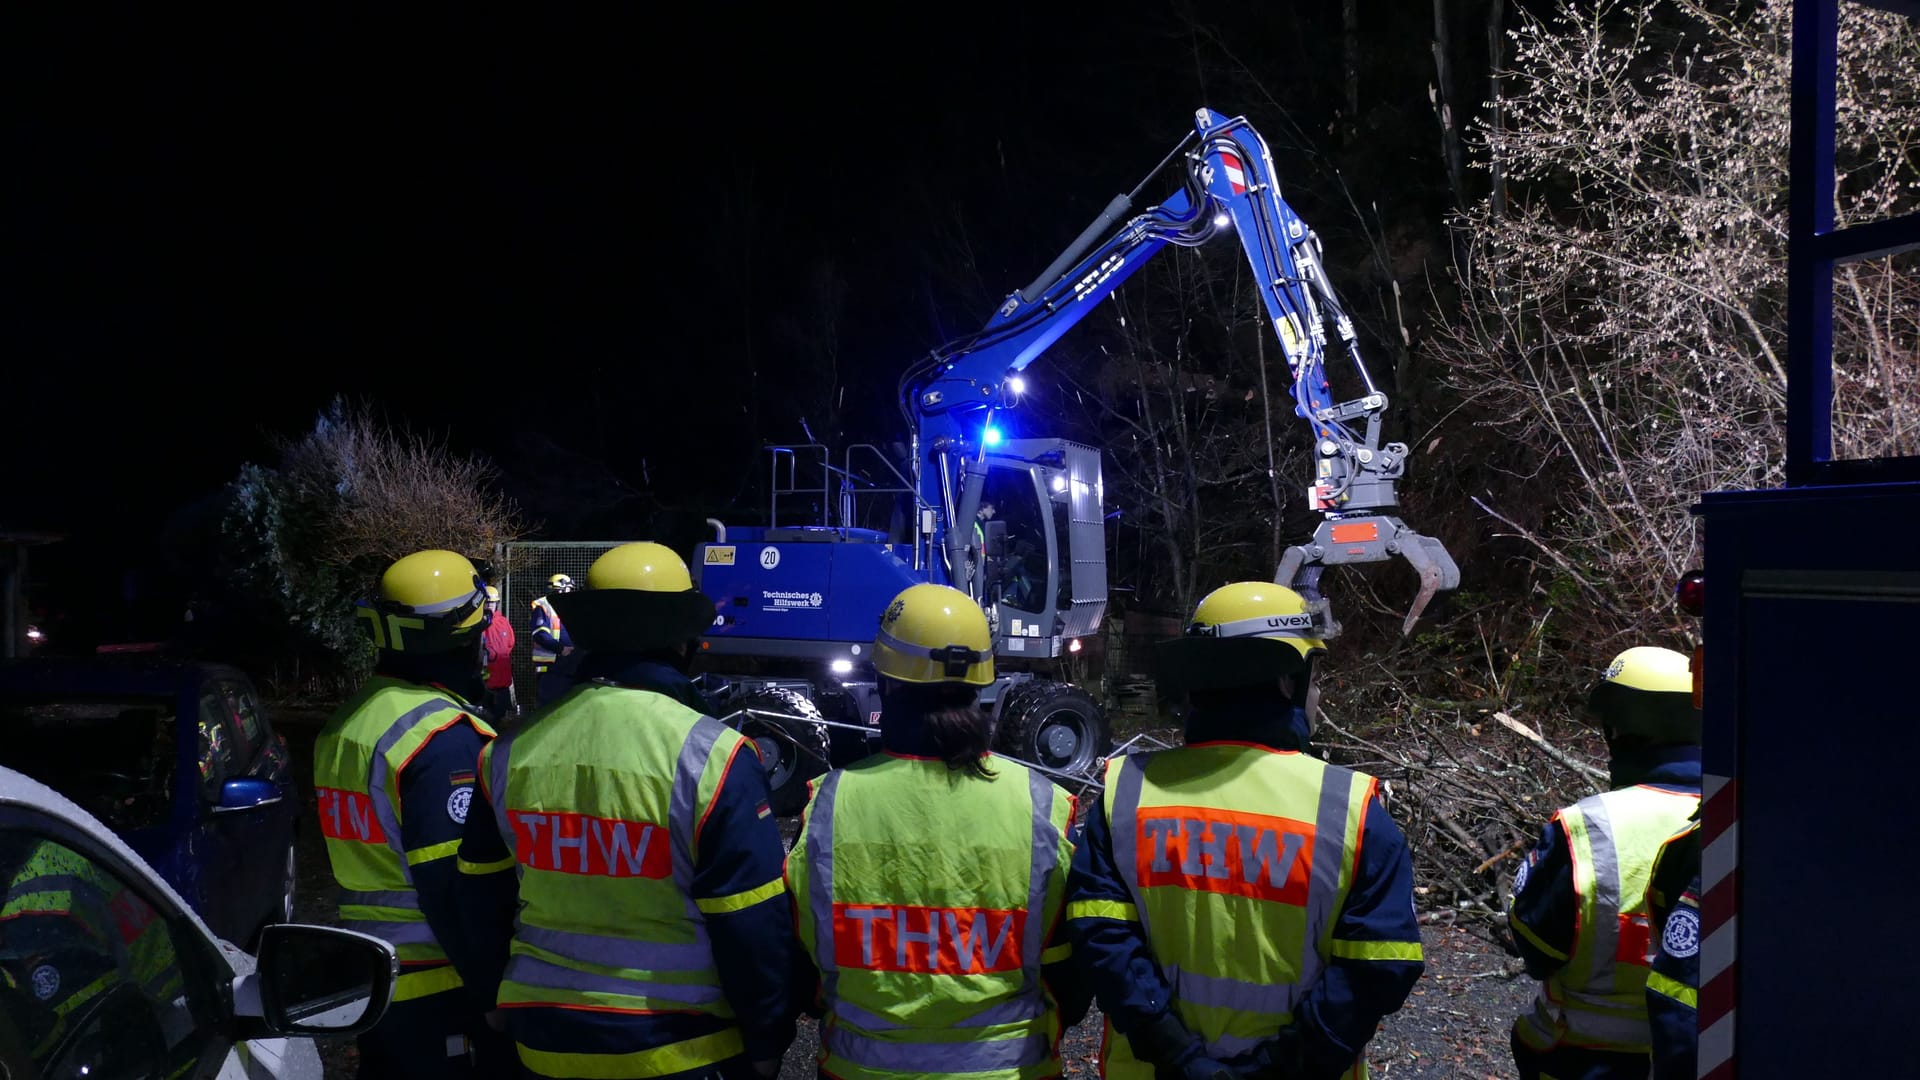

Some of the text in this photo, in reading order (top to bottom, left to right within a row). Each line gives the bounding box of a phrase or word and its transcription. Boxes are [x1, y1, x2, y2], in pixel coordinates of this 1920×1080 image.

[1074, 254, 1125, 301] ATLAS
[764, 551, 776, 565] 20
[762, 591, 810, 600] Technisches
[774, 599, 810, 607] Hilfswerk
[1267, 615, 1311, 627] uvex
[519, 814, 653, 875] THW
[1144, 818, 1305, 889] THW
[844, 908, 1013, 969] THW
